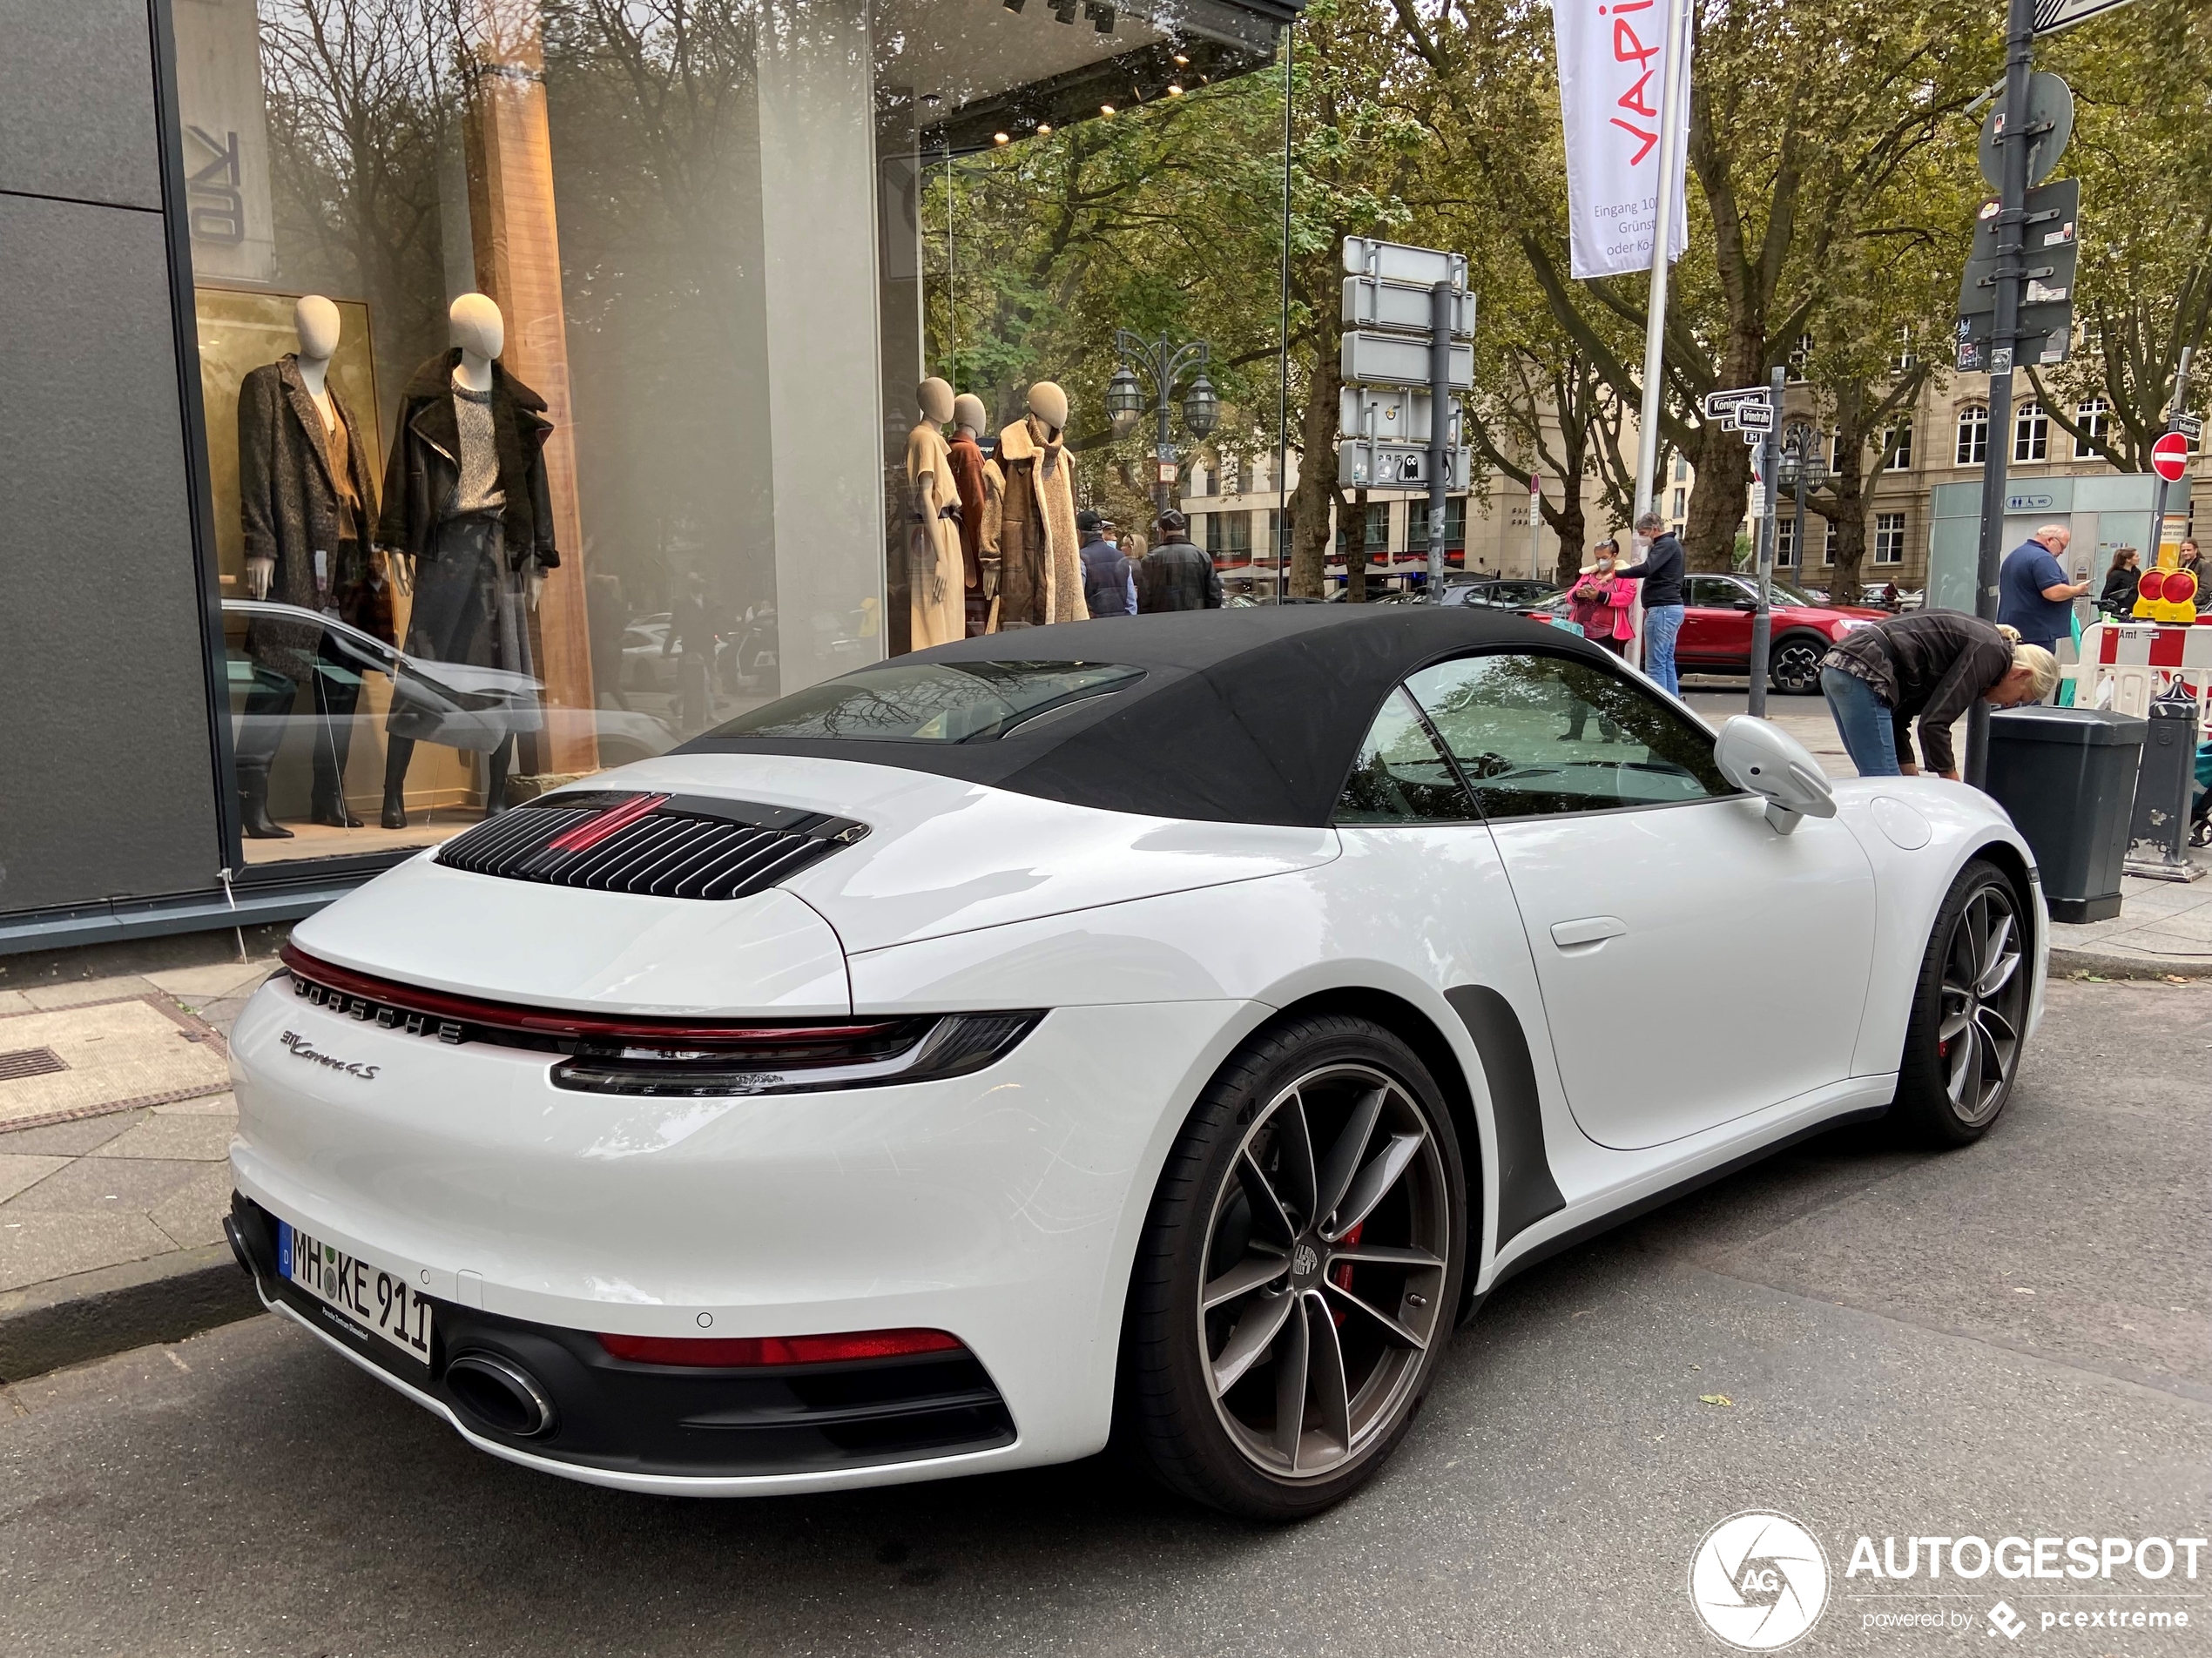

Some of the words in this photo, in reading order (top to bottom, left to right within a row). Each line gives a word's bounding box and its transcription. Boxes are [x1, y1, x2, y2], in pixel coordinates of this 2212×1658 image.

[1594, 203, 1638, 218] Eingang
[1642, 197, 1658, 210] 10
[1607, 242, 1634, 255] oder
[2119, 629, 2137, 639] Amt
[293, 979, 462, 1044] PORSCHE
[284, 1250, 289, 1264] D
[293, 1228, 321, 1290] MH
[339, 1250, 370, 1318] KE
[377, 1272, 428, 1353] 911
